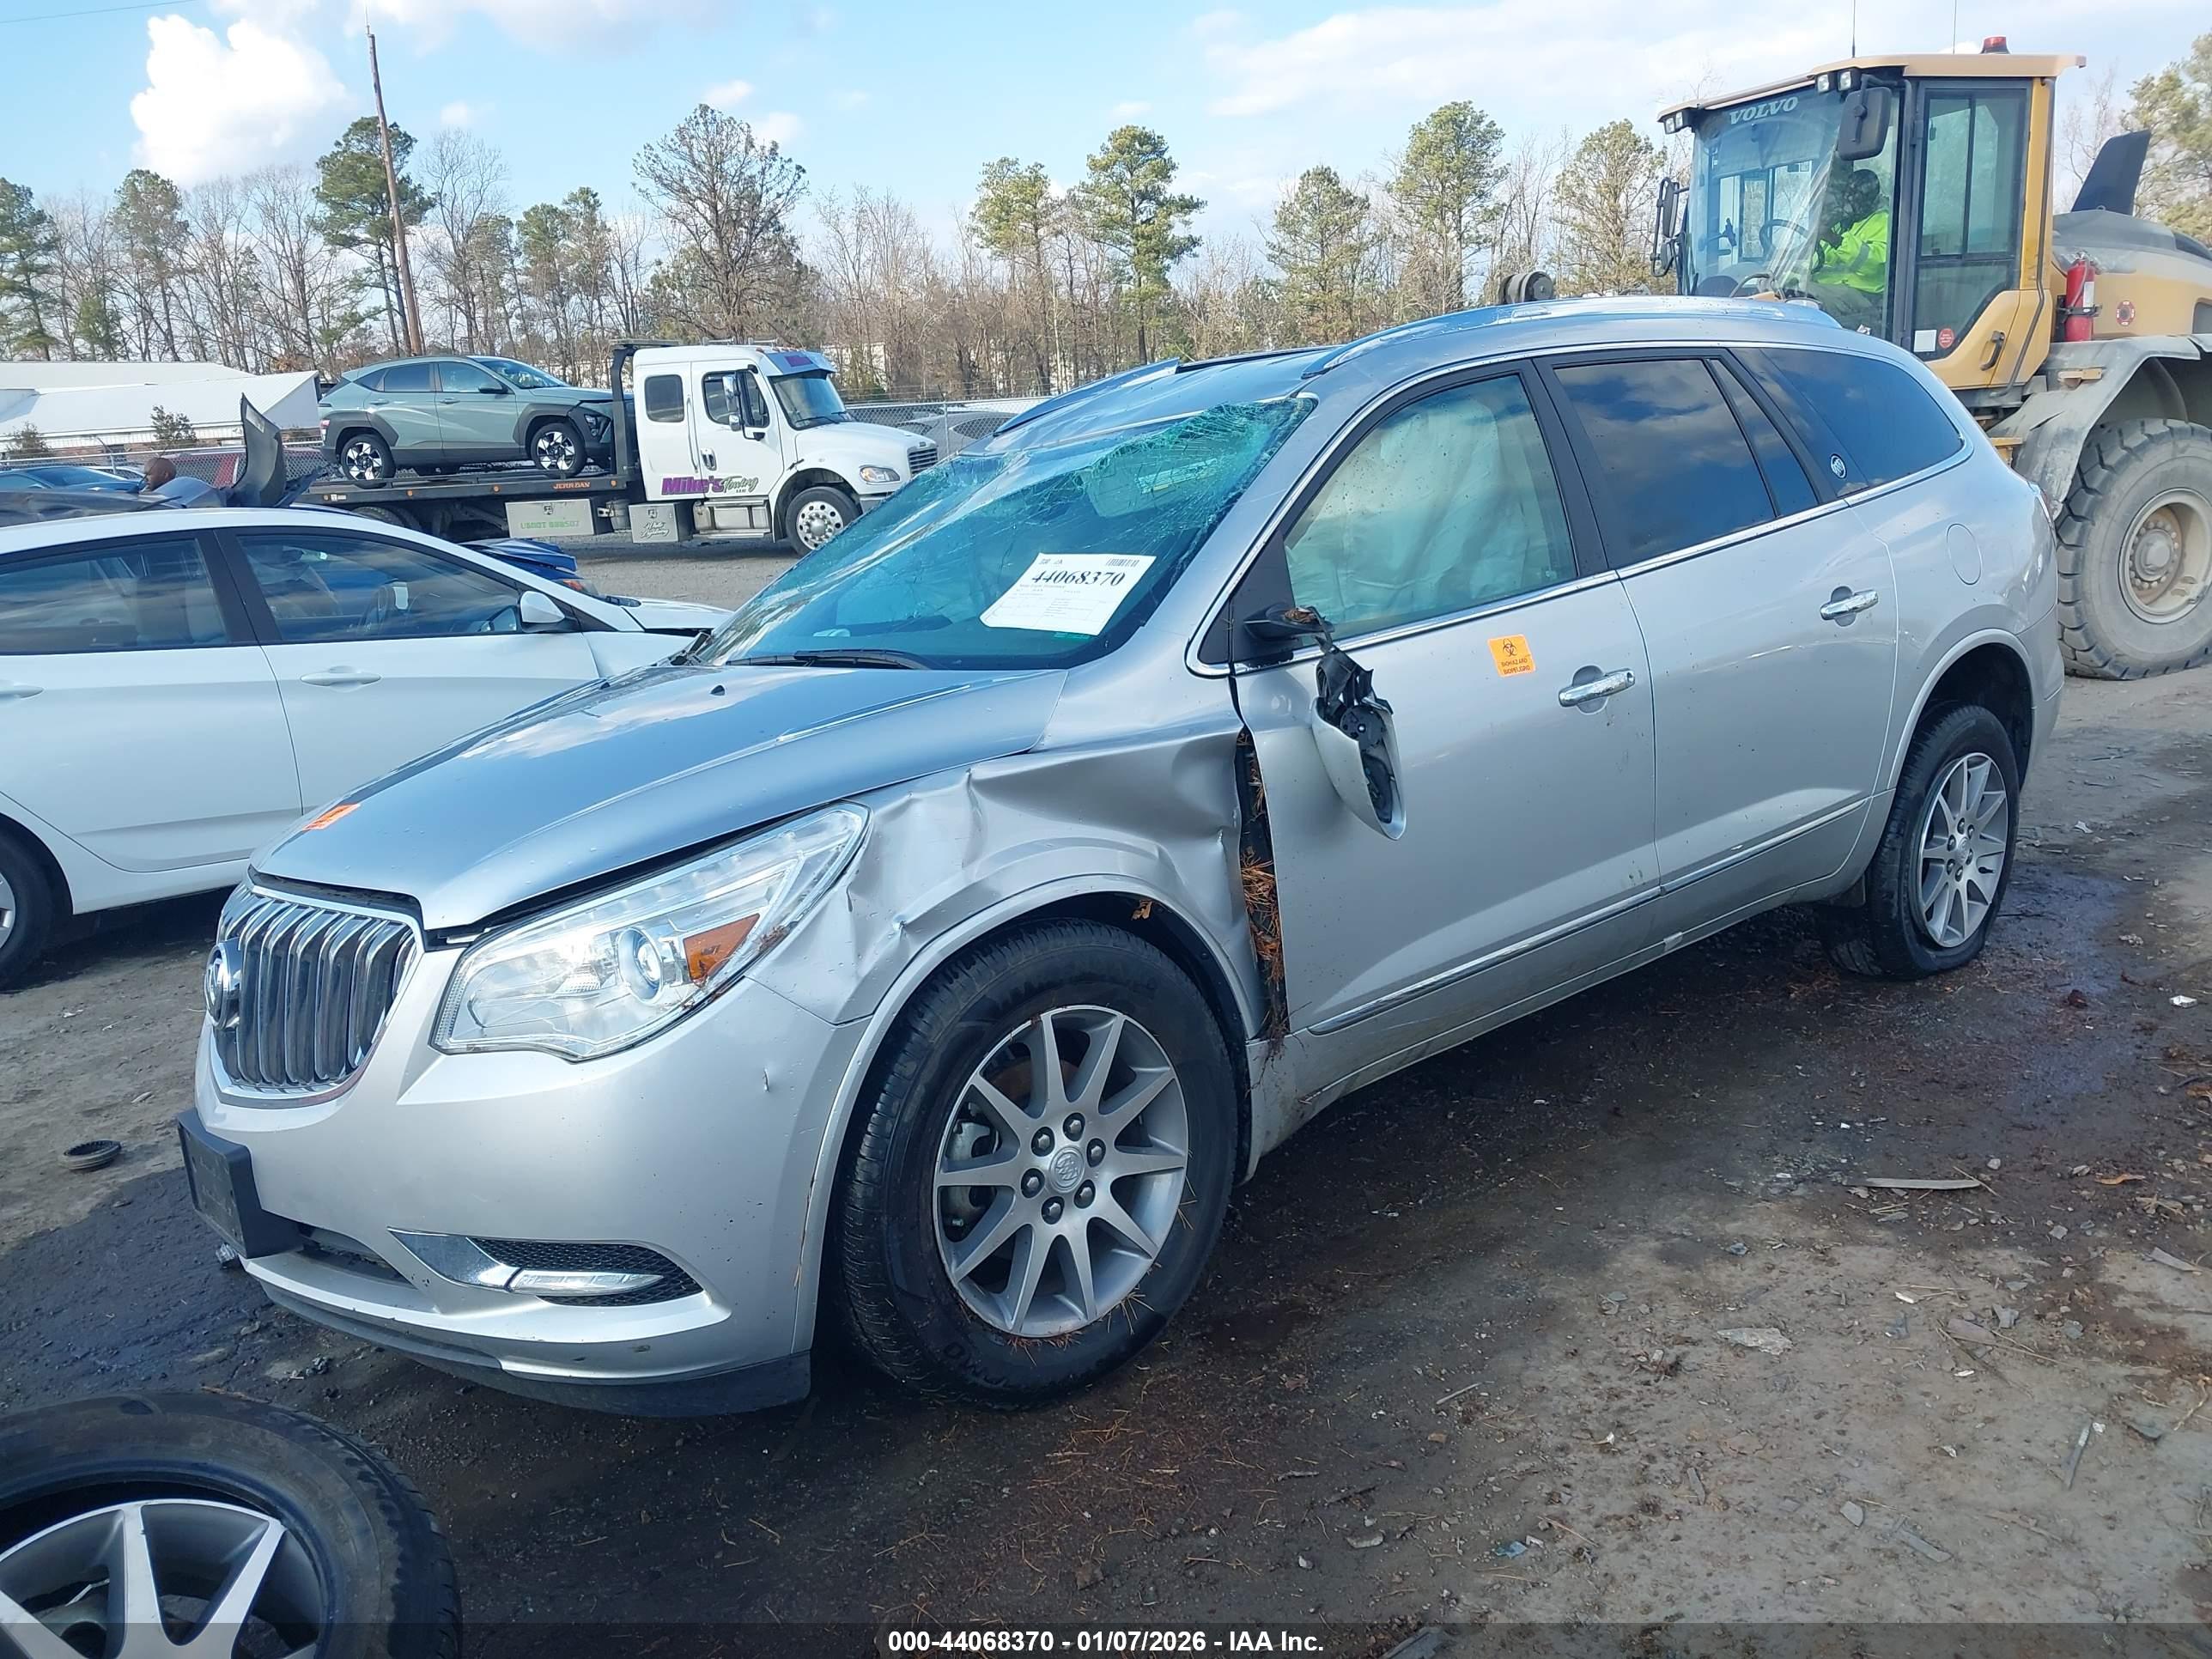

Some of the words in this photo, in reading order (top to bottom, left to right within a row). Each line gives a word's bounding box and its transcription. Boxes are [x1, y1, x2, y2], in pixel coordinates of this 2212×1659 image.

[1729, 96, 1798, 125] VOLVO
[661, 476, 725, 495] Mike's
[721, 476, 759, 493] Towing
[1031, 570, 1126, 586] 44068370
